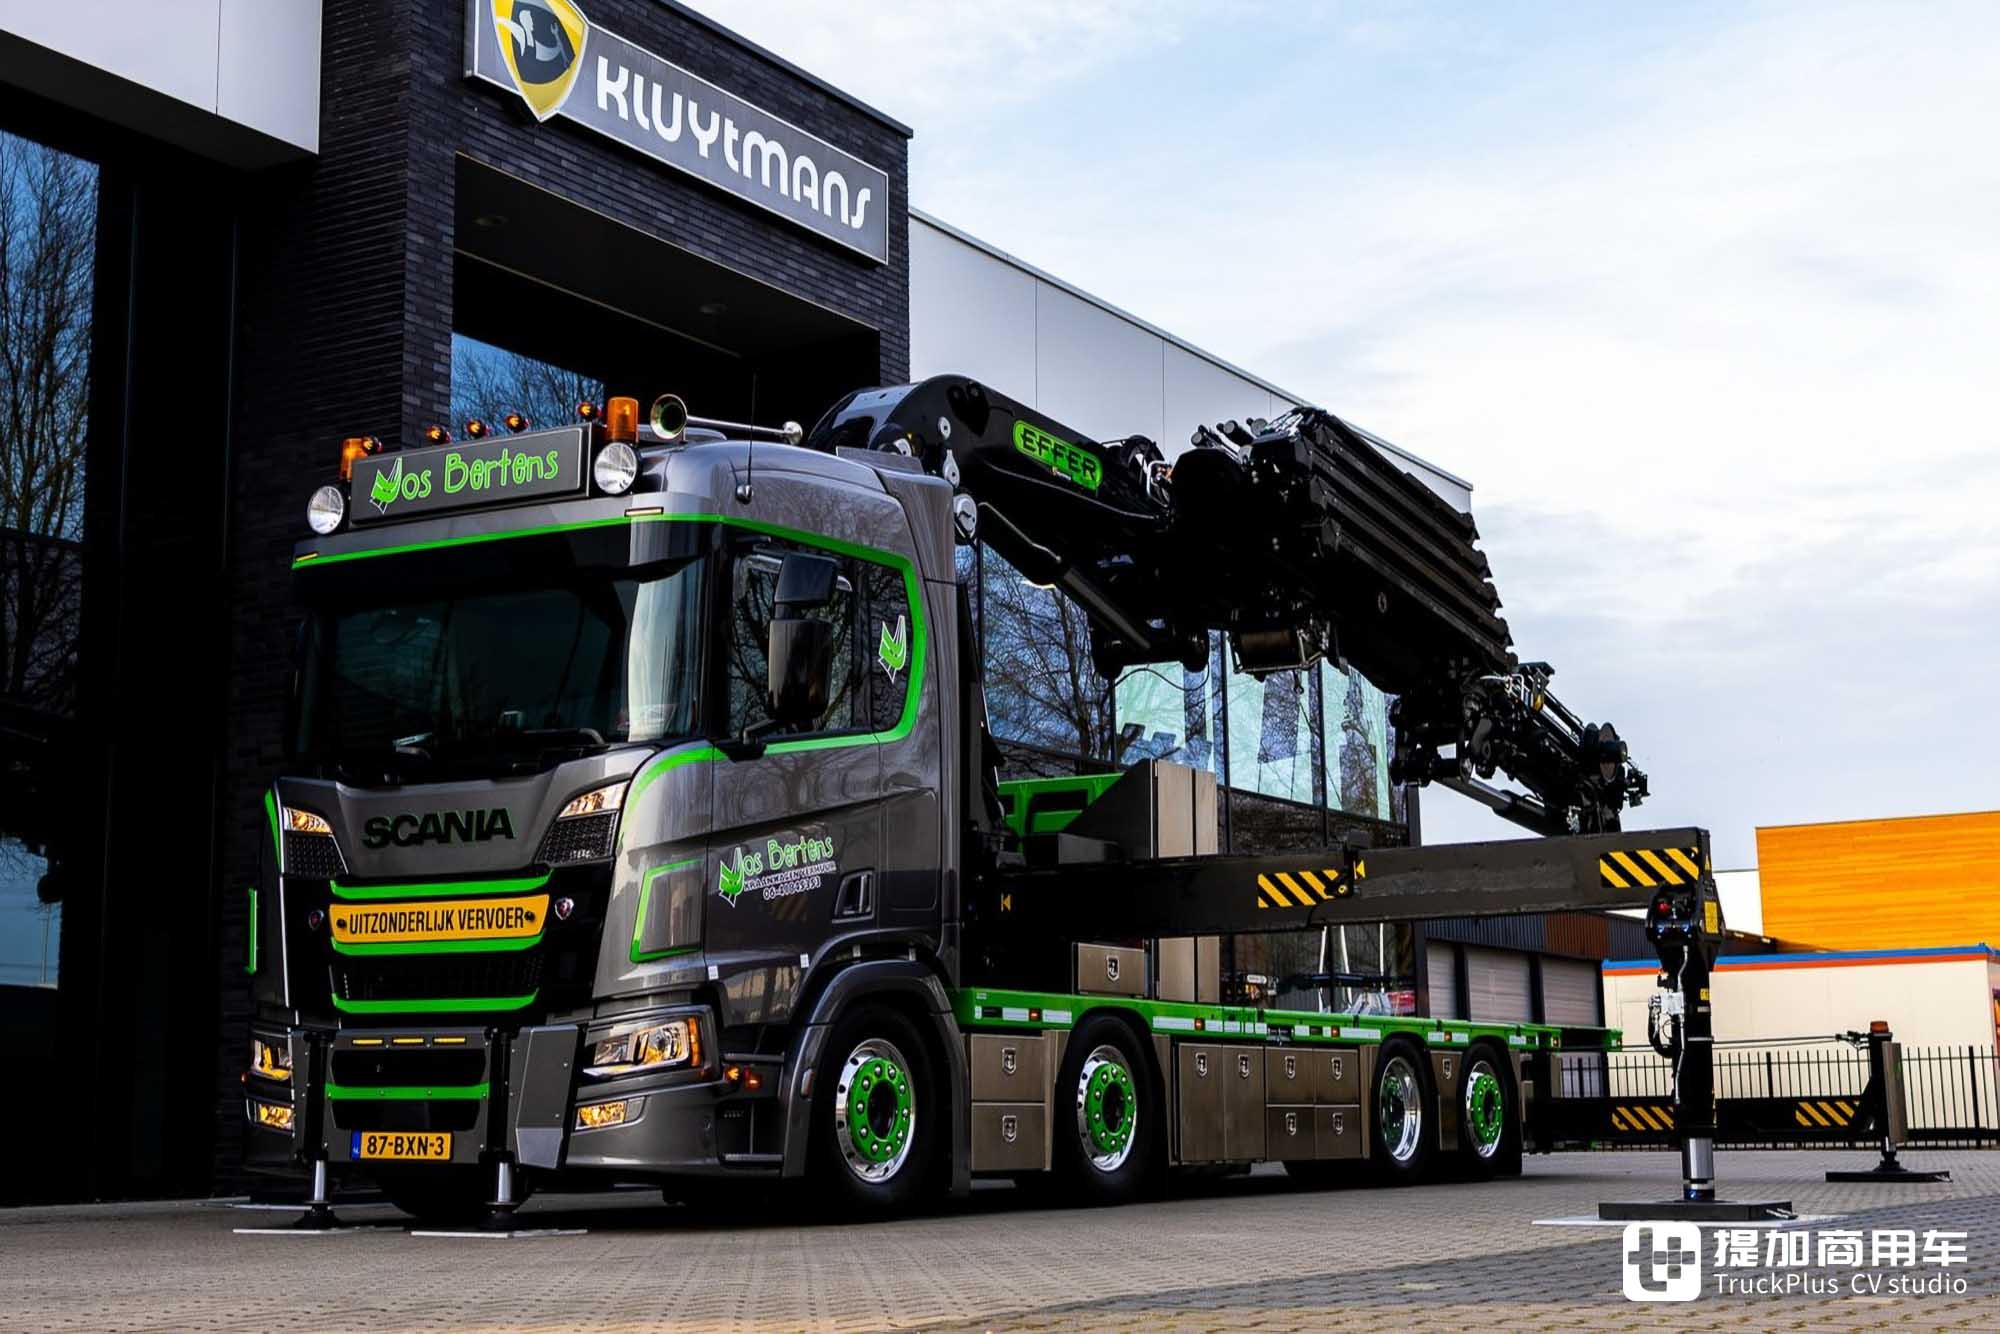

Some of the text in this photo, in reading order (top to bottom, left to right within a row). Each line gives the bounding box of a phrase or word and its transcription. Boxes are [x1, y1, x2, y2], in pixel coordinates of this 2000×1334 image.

[444, 448, 558, 493] Bertens
[1021, 427, 1097, 480] EFFER
[363, 807, 514, 849] SCANIA
[767, 835, 833, 870] Bertens
[350, 907, 524, 935] UITZONDERLIJK VERVOER
[367, 1135, 444, 1156] 87-BXN-3
